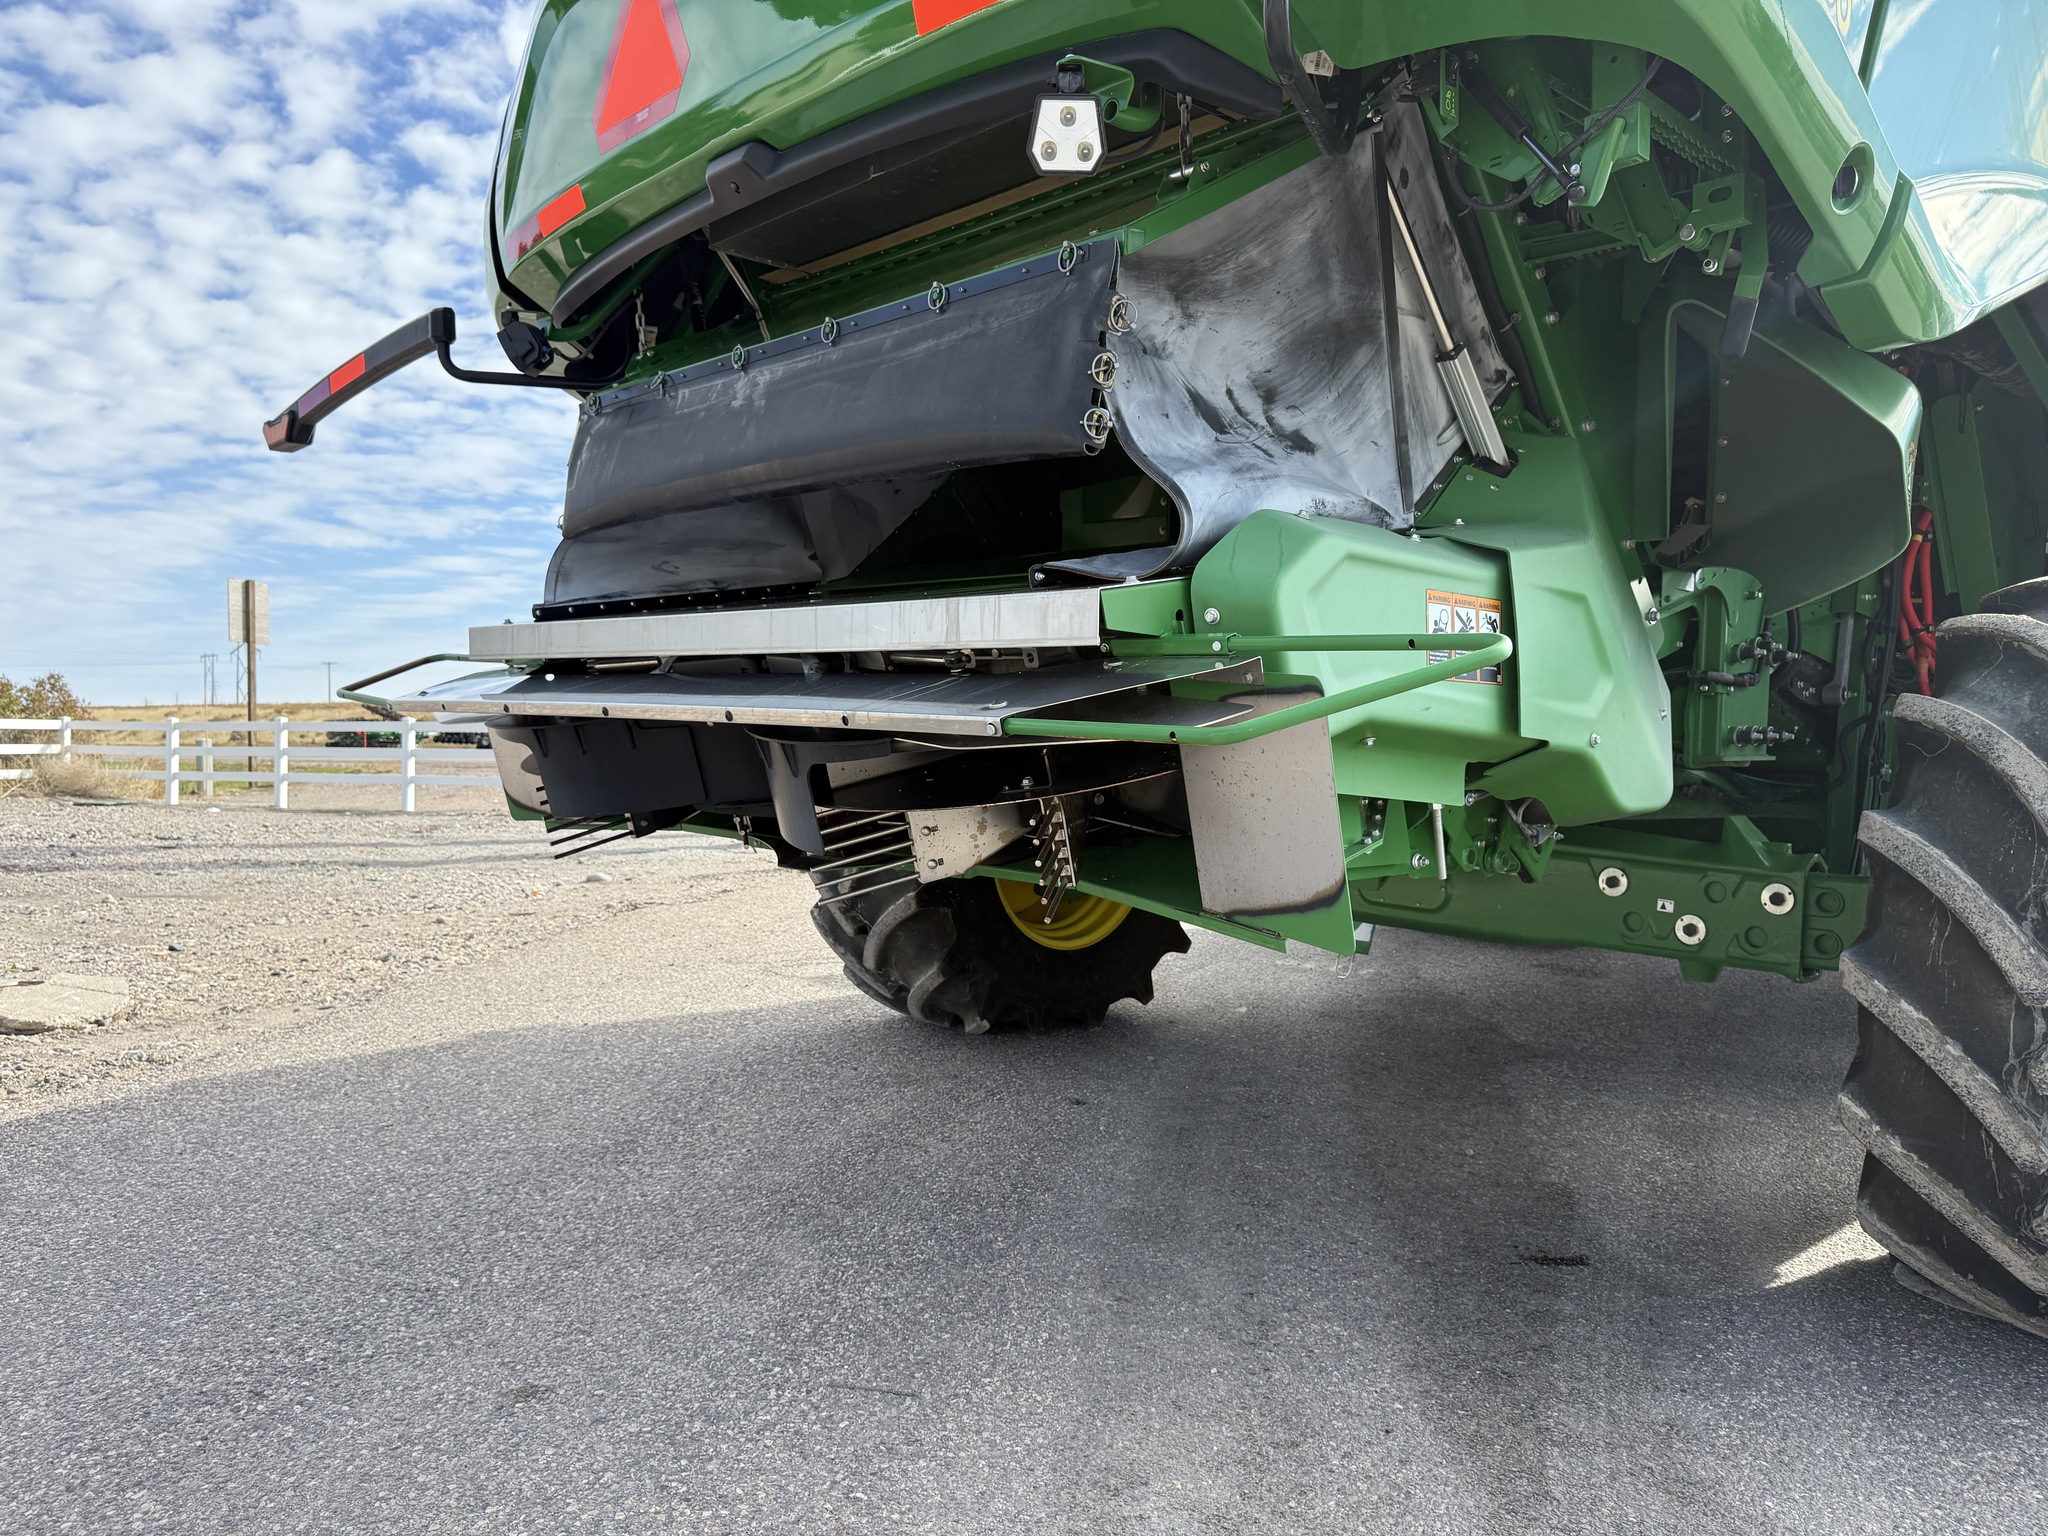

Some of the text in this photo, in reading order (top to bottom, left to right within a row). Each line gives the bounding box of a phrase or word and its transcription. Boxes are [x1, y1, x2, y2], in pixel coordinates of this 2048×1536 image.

[1432, 595, 1450, 603] WARNING
[1457, 599, 1475, 607] WARNING
[1482, 603, 1500, 611] WARNING
